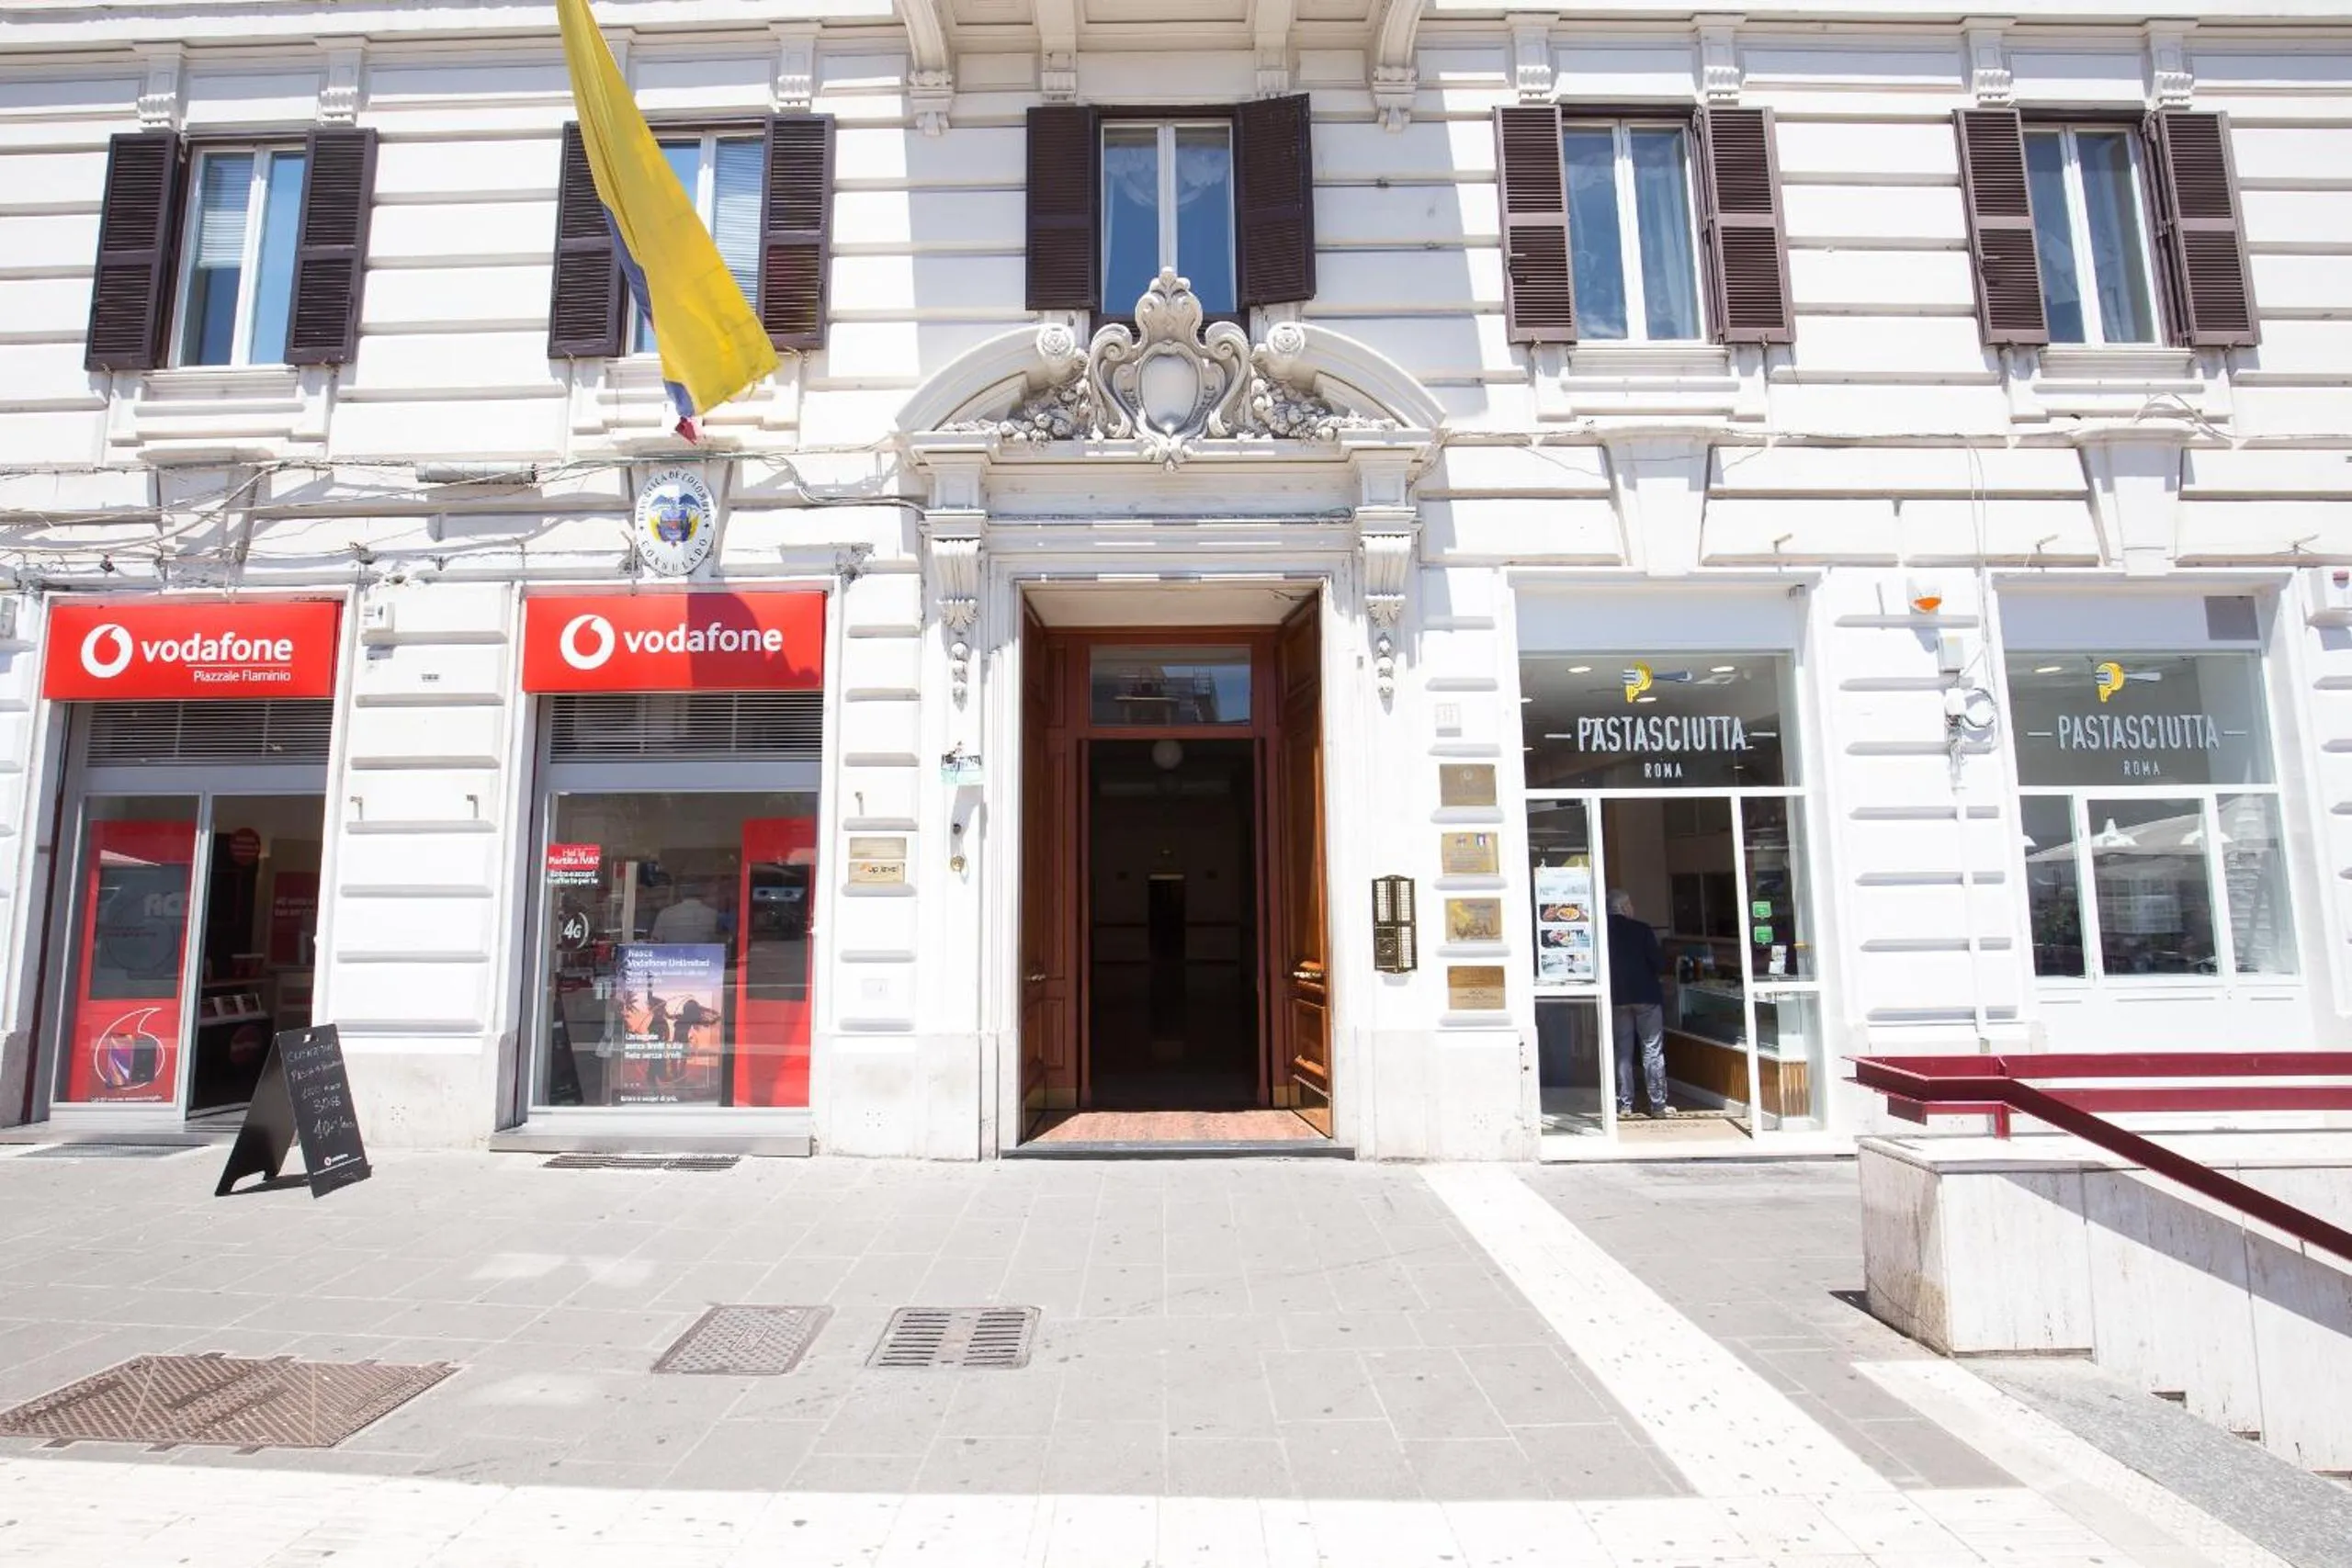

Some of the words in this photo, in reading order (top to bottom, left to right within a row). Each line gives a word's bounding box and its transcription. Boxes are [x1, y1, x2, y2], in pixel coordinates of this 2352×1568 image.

[141, 632, 293, 662] vodafone
[624, 622, 783, 653] vodafone
[194, 670, 240, 682] Piazzale
[242, 670, 291, 682] Flaminio
[1577, 716, 1747, 752] PASTASCIUTTA
[2058, 714, 2220, 750] PASTASCIUTTA
[1644, 762, 1683, 778] ROMA
[2123, 760, 2161, 776] ROMA
[562, 919, 582, 939] 4G
[627, 959, 667, 967] Vodafone
[669, 958, 710, 967] Unlimited
